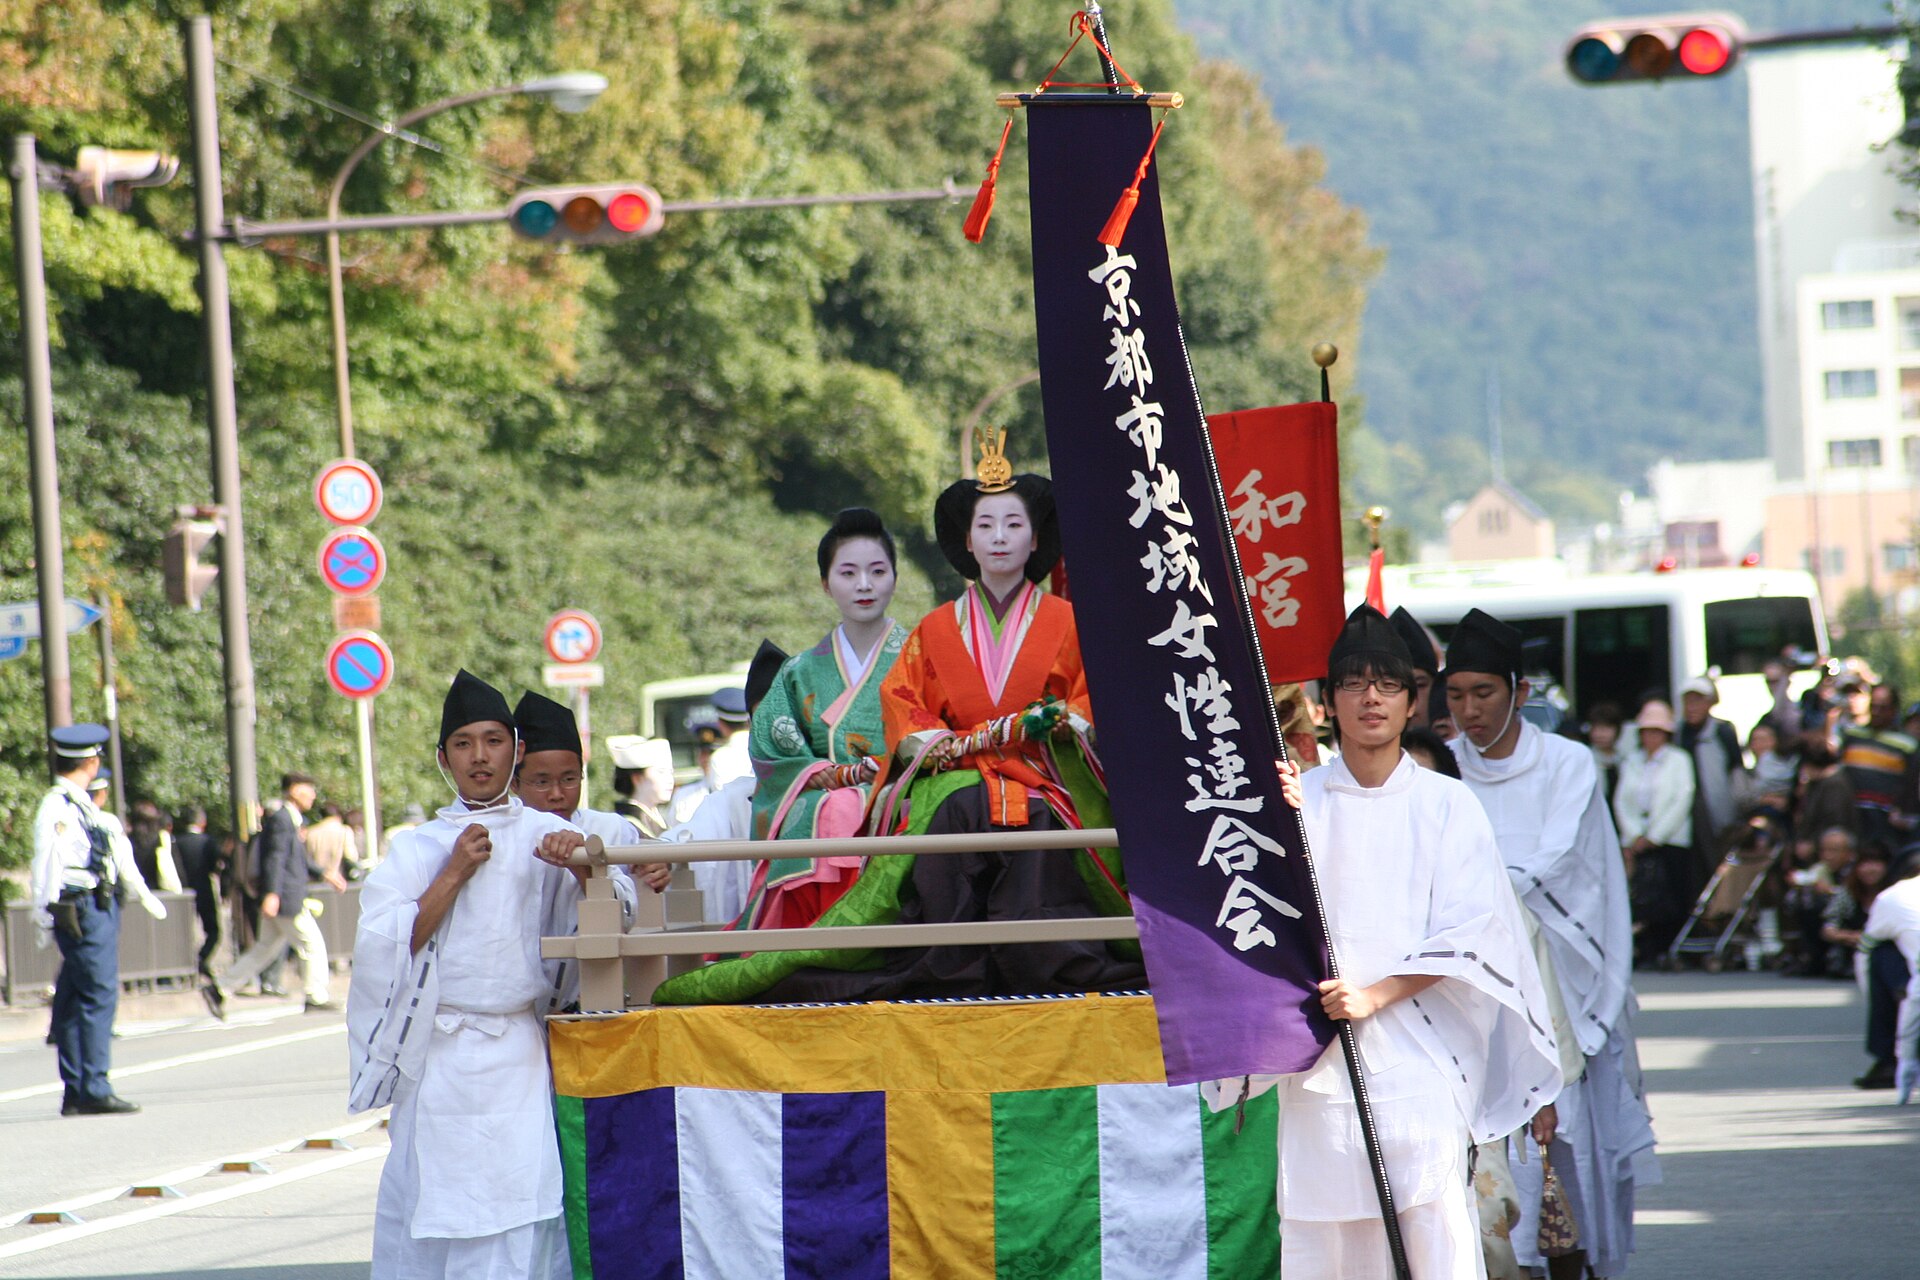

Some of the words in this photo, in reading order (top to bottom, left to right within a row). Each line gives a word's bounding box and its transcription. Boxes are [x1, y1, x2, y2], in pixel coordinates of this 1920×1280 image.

[331, 478, 366, 510] 50
[1229, 469, 1308, 628] 和宮
[1088, 245, 1302, 951] 京都市地域女性連合会
